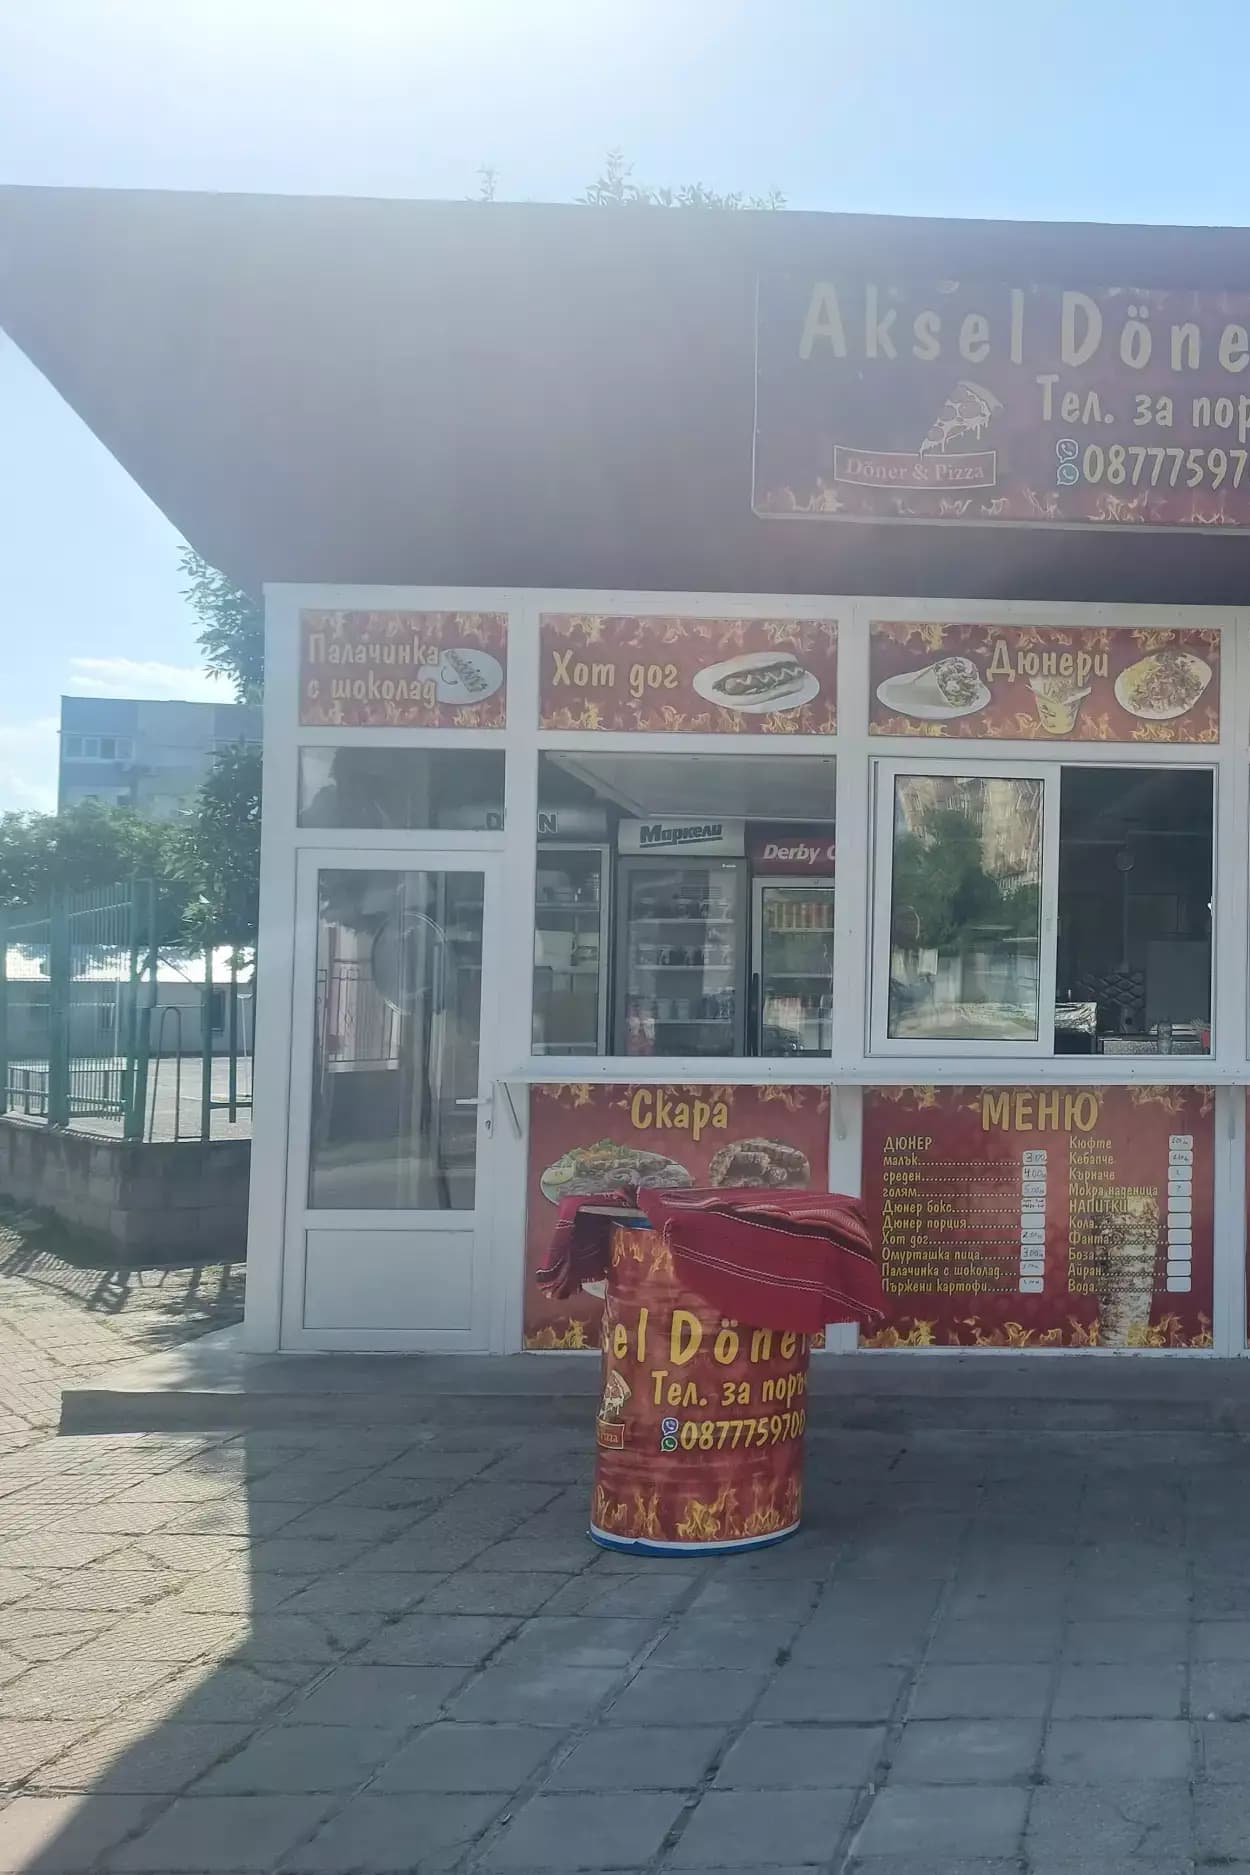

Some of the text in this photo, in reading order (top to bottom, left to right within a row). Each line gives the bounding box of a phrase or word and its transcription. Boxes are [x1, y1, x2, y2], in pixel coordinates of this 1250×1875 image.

[799, 281, 1025, 365] Aksel
[1036, 374, 1115, 424] Тел.
[1133, 394, 1174, 427] за
[847, 458, 985, 481] Döner & Pizza
[309, 633, 439, 665] Палачинка
[986, 640, 1109, 688] Дюнери
[552, 649, 679, 698] Хот дог
[331, 669, 437, 709] шоколад
[640, 824, 723, 847] Маркели
[763, 844, 821, 865] Derby
[631, 1088, 728, 1141] Скара
[981, 1091, 1098, 1131] МЕНЮ
[884, 1136, 933, 1152] ДЮНЕР
[1069, 1135, 1112, 1153] Кюфте
[883, 1152, 918, 1166] малък
[1069, 1151, 1114, 1165] Кебапче
[883, 1170, 922, 1185] среден
[1069, 1166, 1115, 1184] Кърначе
[882, 1186, 918, 1198] голям
[1069, 1182, 1158, 1200] Мокра наденица
[882, 1199, 922, 1215] Дюнер
[1069, 1199, 1129, 1213] НАПИТКИ
[882, 1215, 967, 1233] Дюнер порция
[1069, 1215, 1095, 1229] Кола
[881, 1231, 929, 1249] Хот дог
[1068, 1230, 1110, 1245] Фанта
[881, 1247, 980, 1264] Омурташка пица
[1068, 1247, 1095, 1260] Боза
[881, 1262, 939, 1277] Палачинка
[954, 1263, 1000, 1280] шоколад
[1068, 1262, 1102, 1280] Айран
[881, 1278, 988, 1296] Пържени картофи
[1068, 1279, 1095, 1295] Вода
[651, 1370, 708, 1407] Тел.
[722, 1381, 750, 1407] за
[680, 1408, 806, 1450] 0877759700
